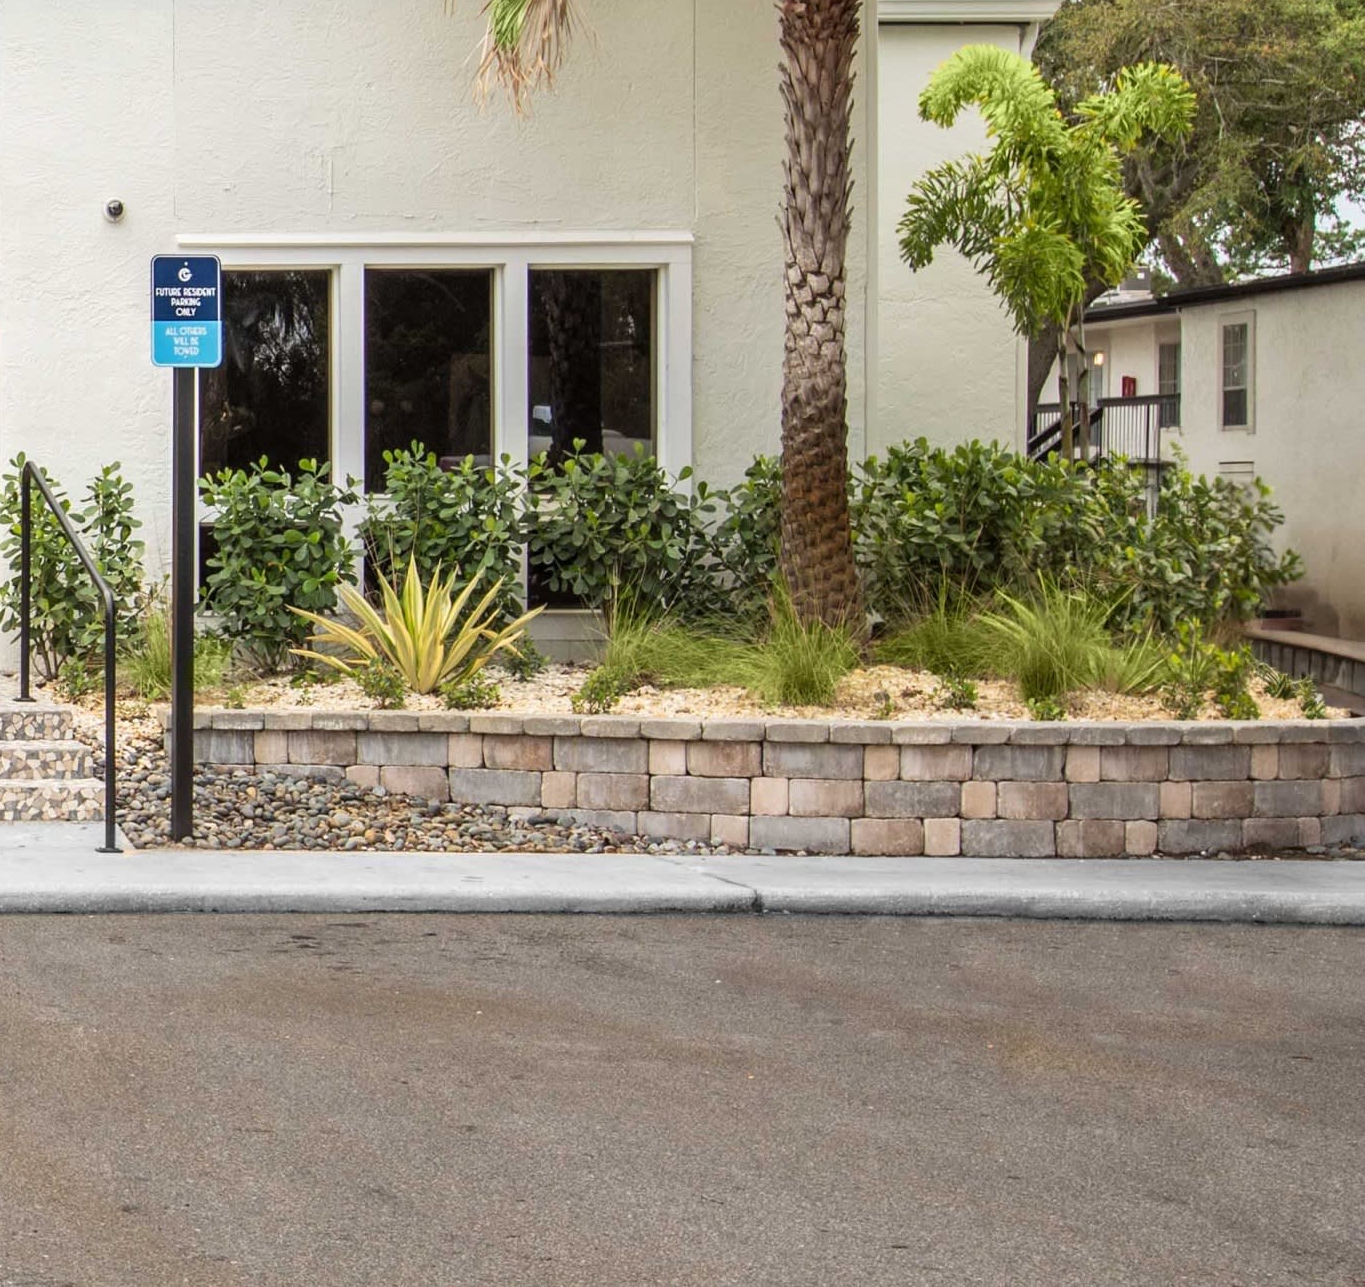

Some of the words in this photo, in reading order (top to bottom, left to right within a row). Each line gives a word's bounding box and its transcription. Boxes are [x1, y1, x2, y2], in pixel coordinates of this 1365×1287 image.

[155, 287, 181, 297] FUTURE
[183, 287, 216, 297] RESIDENT
[171, 297, 201, 307] PARKING
[175, 307, 197, 317] ONLY
[165, 326, 178, 336] ALL
[179, 326, 207, 336] OTHERS
[173, 336, 188, 346] WILL
[189, 336, 199, 346] BE
[173, 346, 200, 356] TOWED
